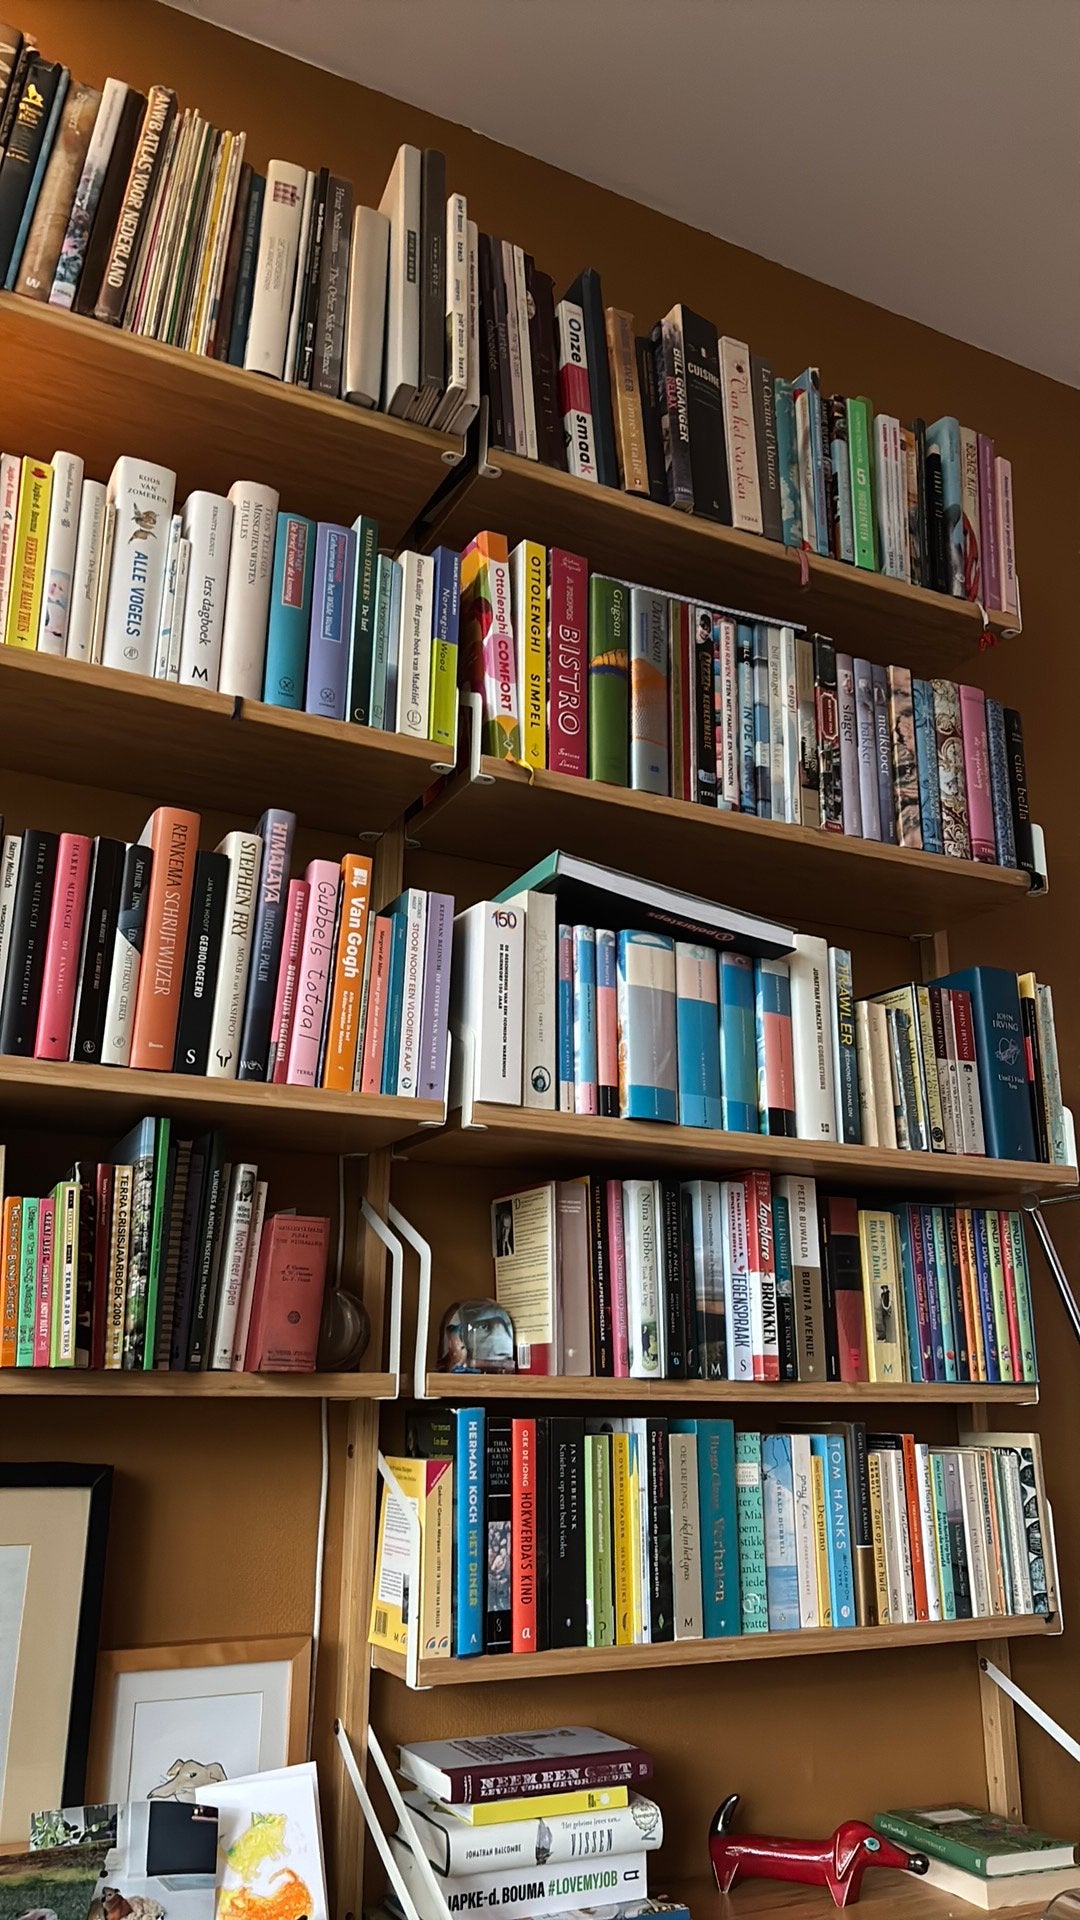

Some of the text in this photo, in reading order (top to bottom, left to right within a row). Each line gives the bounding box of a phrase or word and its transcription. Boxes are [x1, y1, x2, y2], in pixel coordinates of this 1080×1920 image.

[107, 94, 170, 288] ANWB ATLAS VOOR NEDERLAND
[568, 318, 594, 474] Onze smaak
[666, 376, 677, 409] RELAX
[673, 348, 689, 443] BILL GRANGER
[730, 377, 748, 410] Van
[732, 415, 750, 440] het
[761, 368, 778, 490] La Cucina d'Abruzzo
[240, 514, 249, 539] ALLES
[248, 552, 260, 585] WISTEN
[360, 528, 374, 632] MIDAS DEKKERS De larf
[126, 551, 148, 637] ALLE VOGELS
[198, 576, 215, 647] Iers dagboek
[414, 604, 423, 617] Het
[610, 589, 623, 637] Grigson
[413, 619, 422, 638] grote
[413, 638, 421, 656] boek
[439, 588, 451, 672] Norwegian Wood
[495, 568, 512, 712] Ottolenghi COMFORT
[530, 556, 541, 729] OTTOLENGHI SIMPEL
[410, 672, 420, 707] Madelief
[558, 624, 581, 735] BISTRO
[724, 652, 732, 678] RAVEN
[769, 645, 780, 697] bill granger
[743, 706, 753, 721] IN
[744, 724, 754, 743] DE
[842, 704, 855, 744] slager
[860, 721, 872, 766] bakker
[878, 715, 890, 776] melkboer
[1014, 754, 1029, 820] ciao bella
[3, 841, 18, 888] Harry Mulisch
[63, 844, 80, 930] HARRY MULISCH
[235, 840, 257, 908] STEPHEN
[153, 823, 188, 996] RENKEMA SCHRIJFWIJZER
[230, 911, 250, 941] FRY
[258, 822, 288, 982] HIMALAYA MICHAEL PALIN
[491, 910, 518, 929] 150
[298, 881, 336, 1042] Gubbels totaal
[342, 897, 366, 979] Van Gogh
[193, 935, 209, 998] GEBIOLOGEERD
[812, 968, 820, 1000] JONATHAN
[404, 923, 420, 1072] STOOR NOOIT EEN VLOOIENDE AAP
[836, 963, 853, 1046] TRAWLER
[209, 1169, 220, 1204] VLINDERS
[205, 1211, 216, 1239] ANDERE
[641, 1193, 653, 1263] Nina Stibbe
[112, 1175, 129, 1326] TERRA CRISISJAARBOEK 2009
[202, 1241, 213, 1275] INSECTEN
[226, 1230, 247, 1306] Nooit meer slapen
[757, 1200, 776, 1346] Zapklare BROKKEN
[797, 1184, 815, 1358] PETER BUWALDA BONITA AVENUE
[197, 1284, 208, 1319] Nederland
[731, 1271, 750, 1348] TEGENSPRAAK
[521, 1462, 529, 1487] JONG
[559, 1444, 567, 1478] Knielen
[558, 1480, 566, 1493] op
[830, 1442, 847, 1550] TOM HANKS
[468, 1421, 478, 1607] HERMAN KOCH HET DINER
[520, 1492, 532, 1570] HOKWERDA'S
[816, 1521, 826, 1552] piano
[982, 1481, 993, 1545] BEFORE DYING
[560, 1530, 568, 1558] violen
[520, 1575, 532, 1605] KIND
[480, 1767, 582, 1791] NEEM EEN
[466, 1847, 494, 1860] JONATHAN
[571, 1828, 614, 1857] VISSEN
[502, 1881, 546, 1904] BOUMA
[548, 1870, 619, 1897] #LOVEMYJOB
